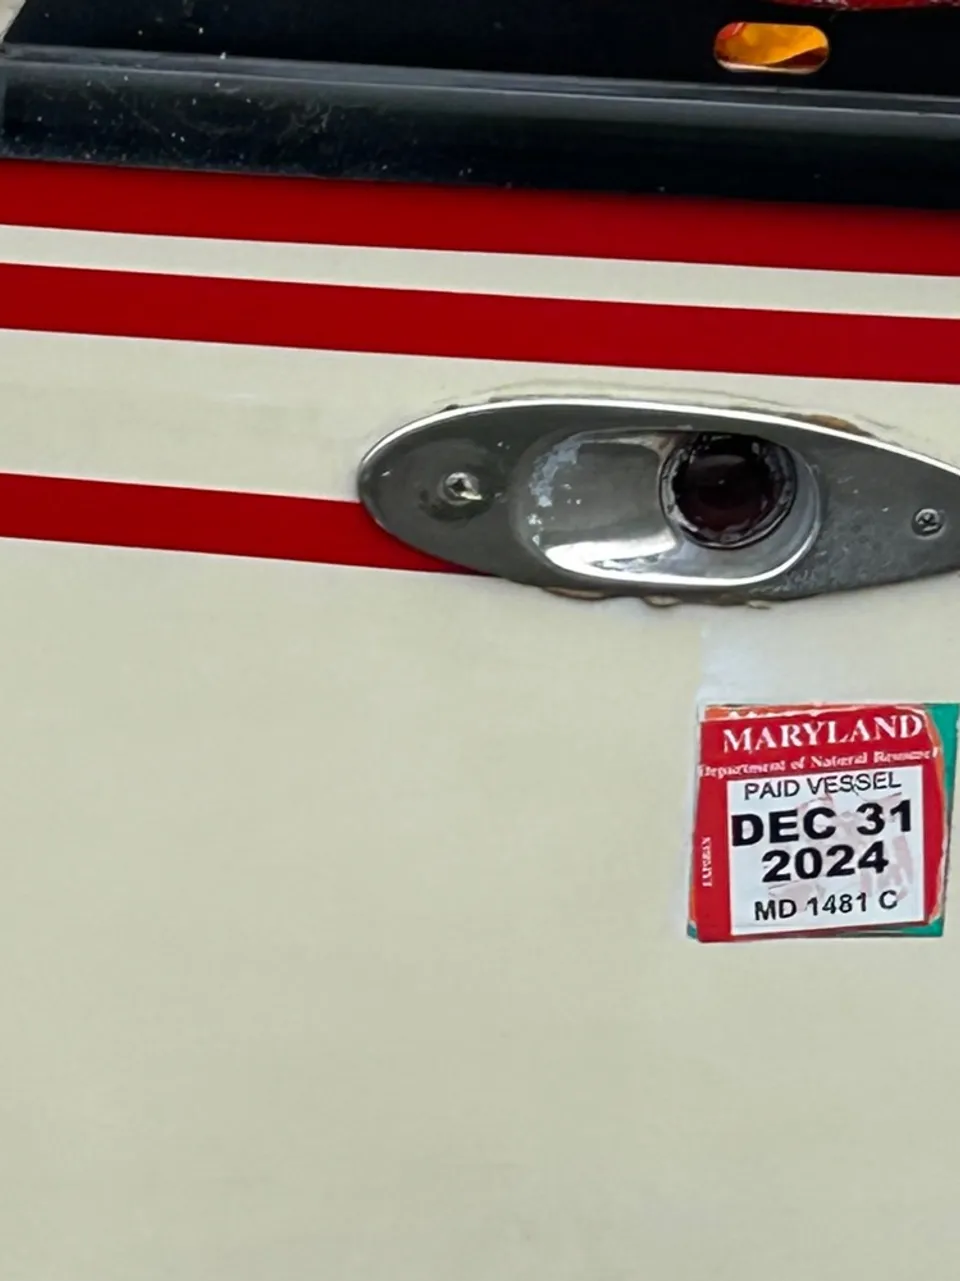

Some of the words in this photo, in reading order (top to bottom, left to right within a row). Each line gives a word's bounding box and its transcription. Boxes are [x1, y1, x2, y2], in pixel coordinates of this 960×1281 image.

[723, 714, 924, 753] MARYLAND
[790, 756, 806, 770] of
[810, 752, 868, 769] Natural
[744, 779, 800, 800] PAID
[807, 772, 902, 795] VESSEL
[731, 807, 836, 847] DEC
[856, 799, 912, 836] 31
[761, 841, 889, 883] 2024
[754, 899, 797, 921] MD
[807, 893, 868, 916] 1481
[879, 890, 899, 910] C
